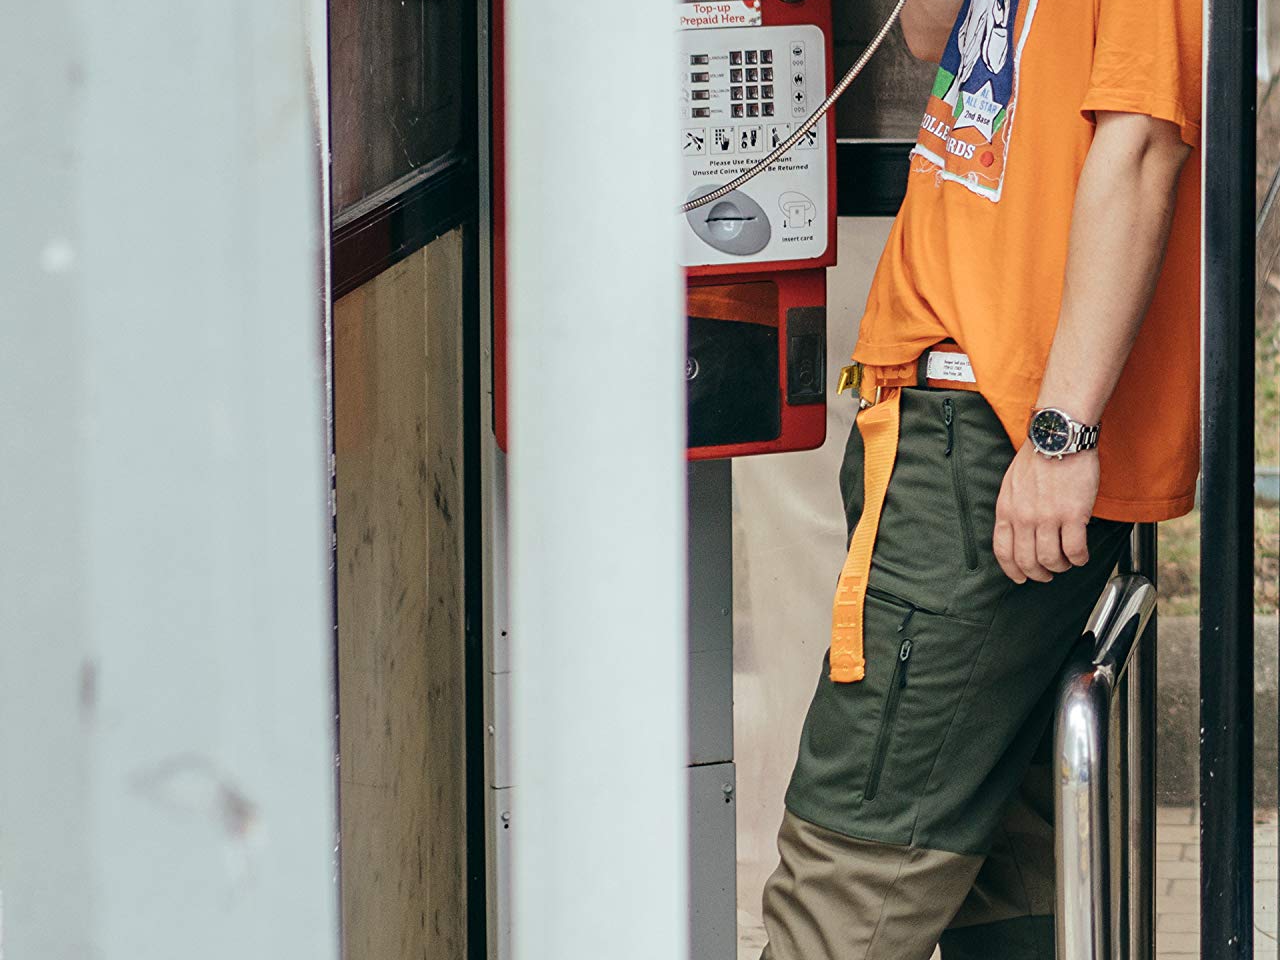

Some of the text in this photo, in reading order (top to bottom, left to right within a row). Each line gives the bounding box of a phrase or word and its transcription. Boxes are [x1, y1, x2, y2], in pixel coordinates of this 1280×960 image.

[693, 4, 731, 14] Top-up
[680, 14, 719, 26] Prepaid
[721, 14, 745, 23] Here
[965, 95, 998, 114] ALL STAR
[964, 110, 991, 126] 2nd Base
